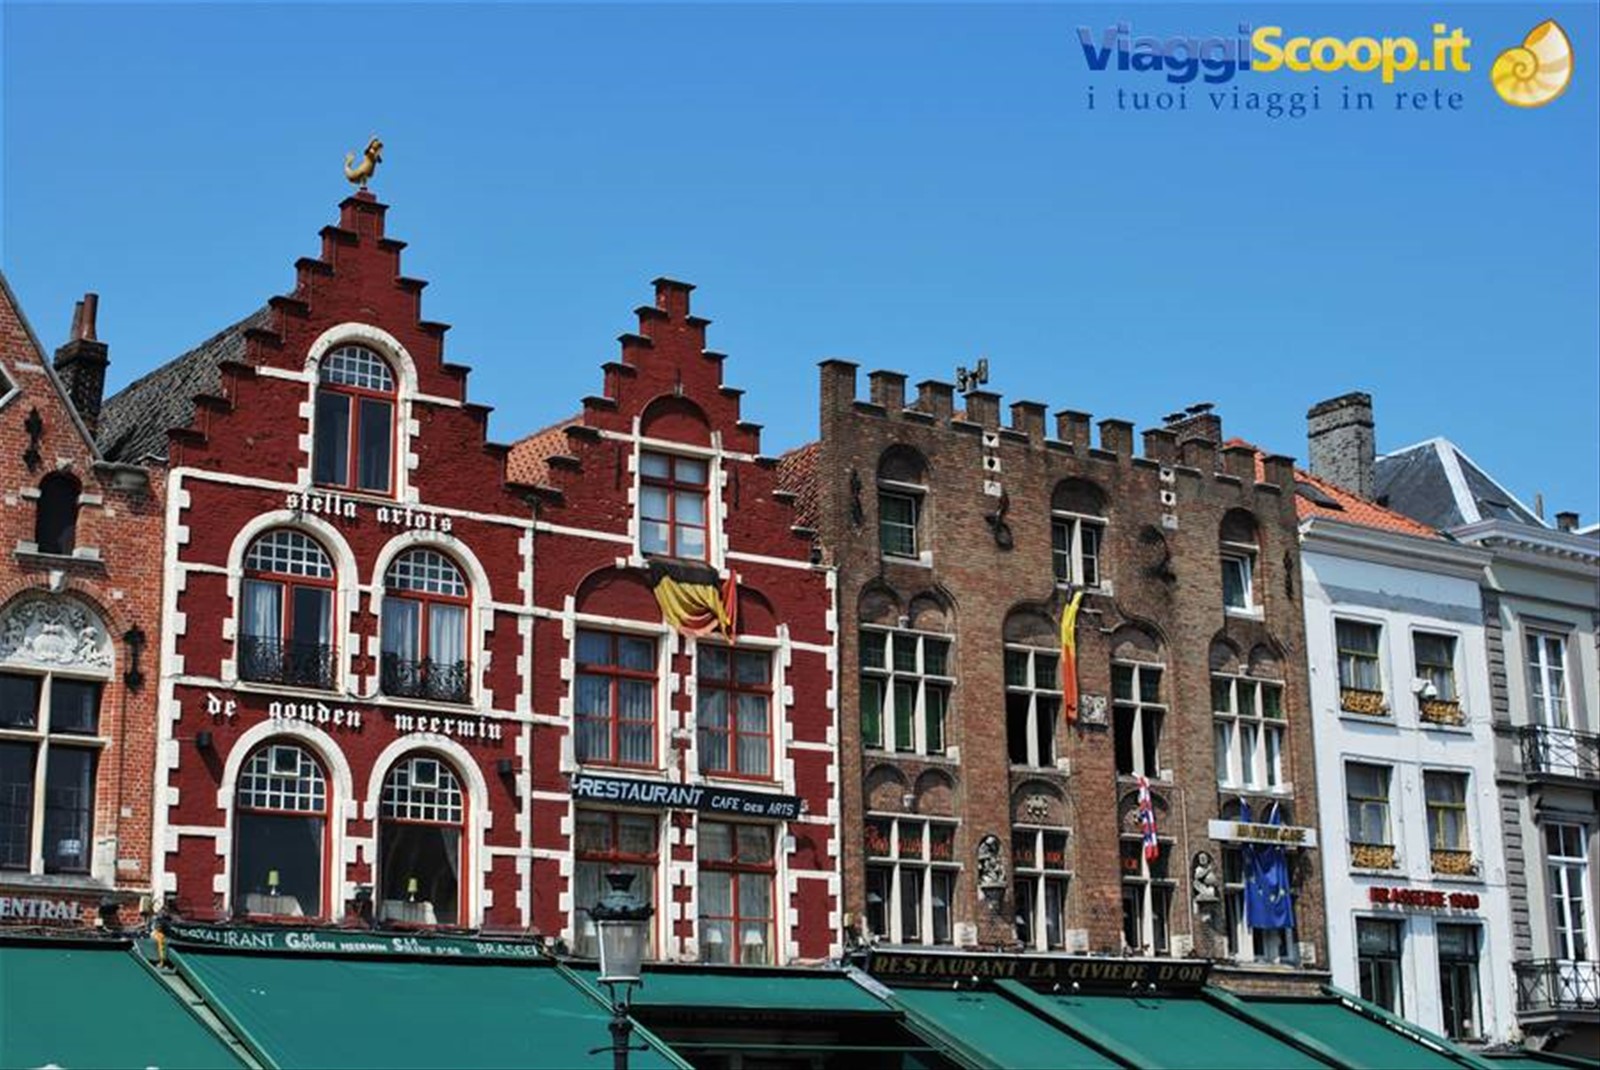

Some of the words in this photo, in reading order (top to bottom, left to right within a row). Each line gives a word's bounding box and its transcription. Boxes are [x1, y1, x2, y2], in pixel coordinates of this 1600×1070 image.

[286, 491, 356, 518] stella
[376, 505, 453, 532] artois
[206, 693, 237, 716] de
[268, 700, 362, 728] gouden
[394, 712, 502, 740] meermin
[578, 776, 704, 806] RESTAURANT
[766, 803, 795, 816] ARTS
[874, 955, 1018, 977] RESTAURANT
[1029, 960, 1057, 978] LA
